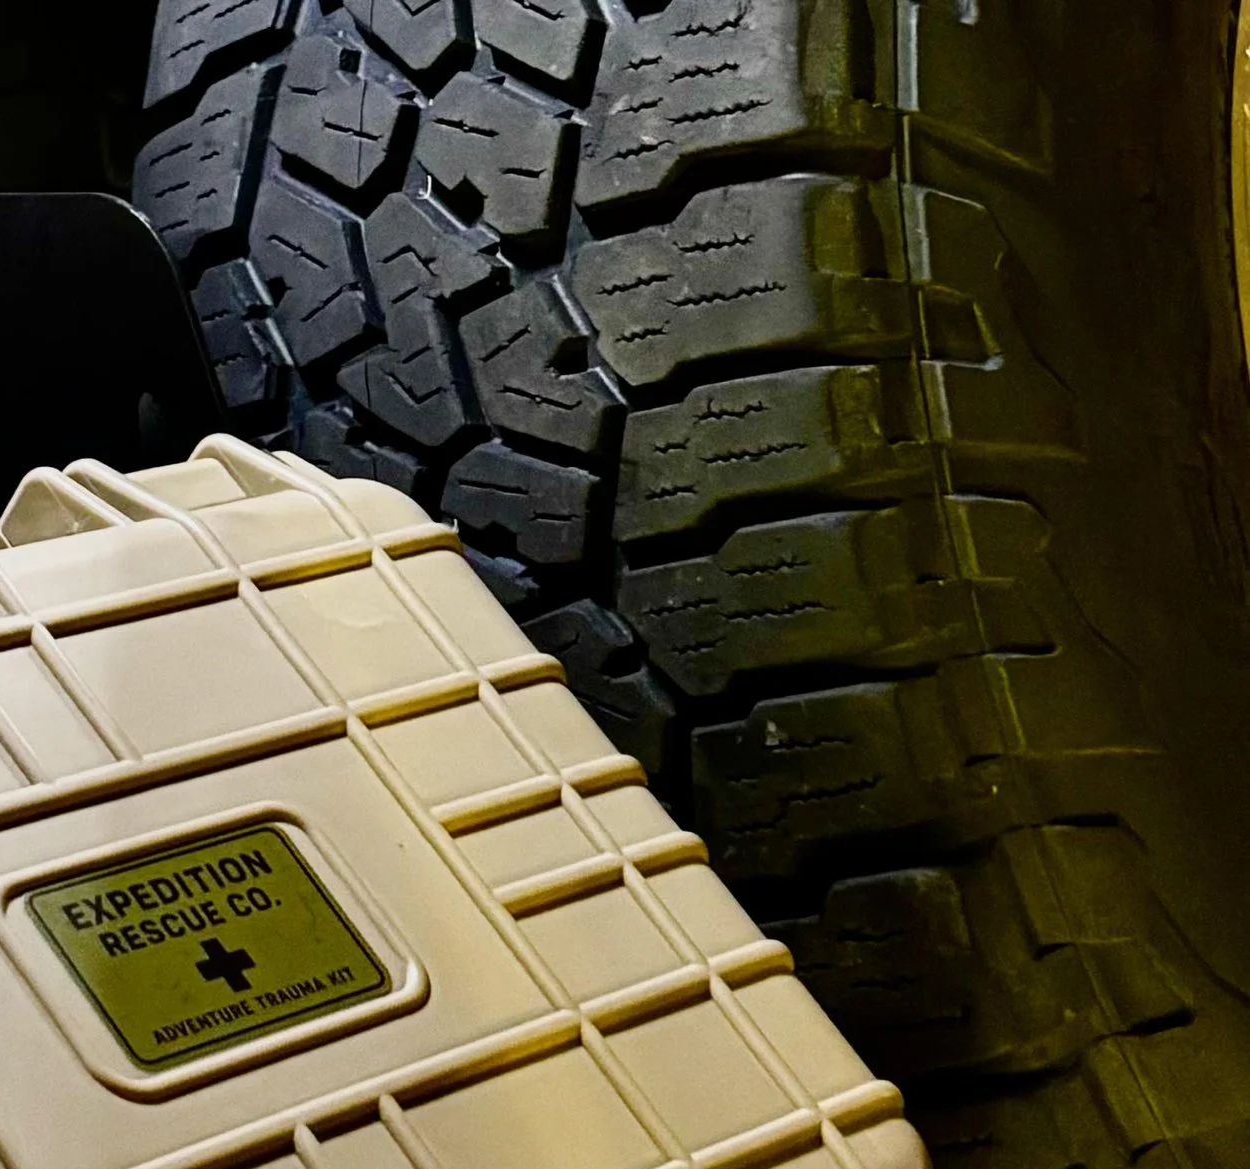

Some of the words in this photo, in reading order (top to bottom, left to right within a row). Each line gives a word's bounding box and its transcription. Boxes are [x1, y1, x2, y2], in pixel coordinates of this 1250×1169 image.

[62, 850, 272, 930] EXPEDITION
[98, 902, 226, 957] RESCUE
[229, 886, 282, 918] CO.
[153, 1001, 255, 1046] ADVENTURE
[256, 981, 327, 1010] TRAUMA
[327, 966, 357, 987] KIT
